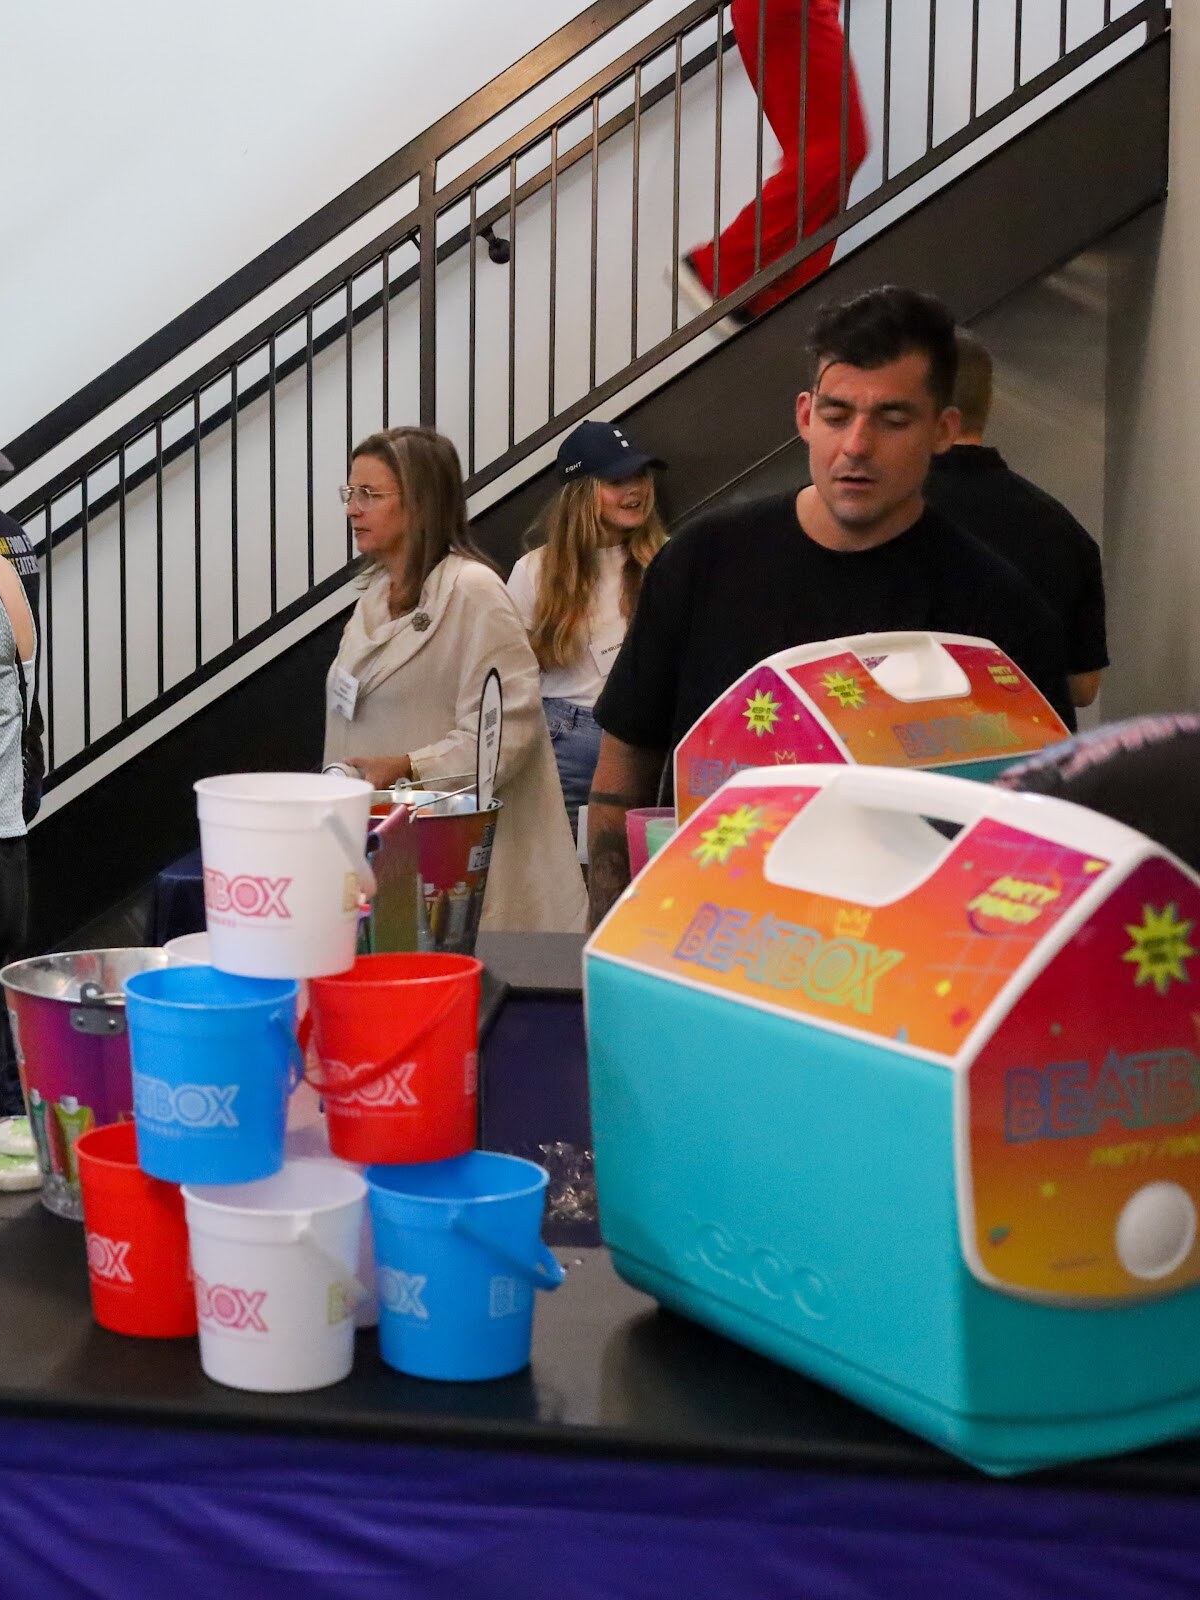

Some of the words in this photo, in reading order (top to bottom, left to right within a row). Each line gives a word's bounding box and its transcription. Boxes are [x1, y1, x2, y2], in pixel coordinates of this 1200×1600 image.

[564, 461, 582, 474] EIGHT
[672, 902, 905, 1016] BEATBOX
[1003, 1047, 1200, 1146] BEATB
